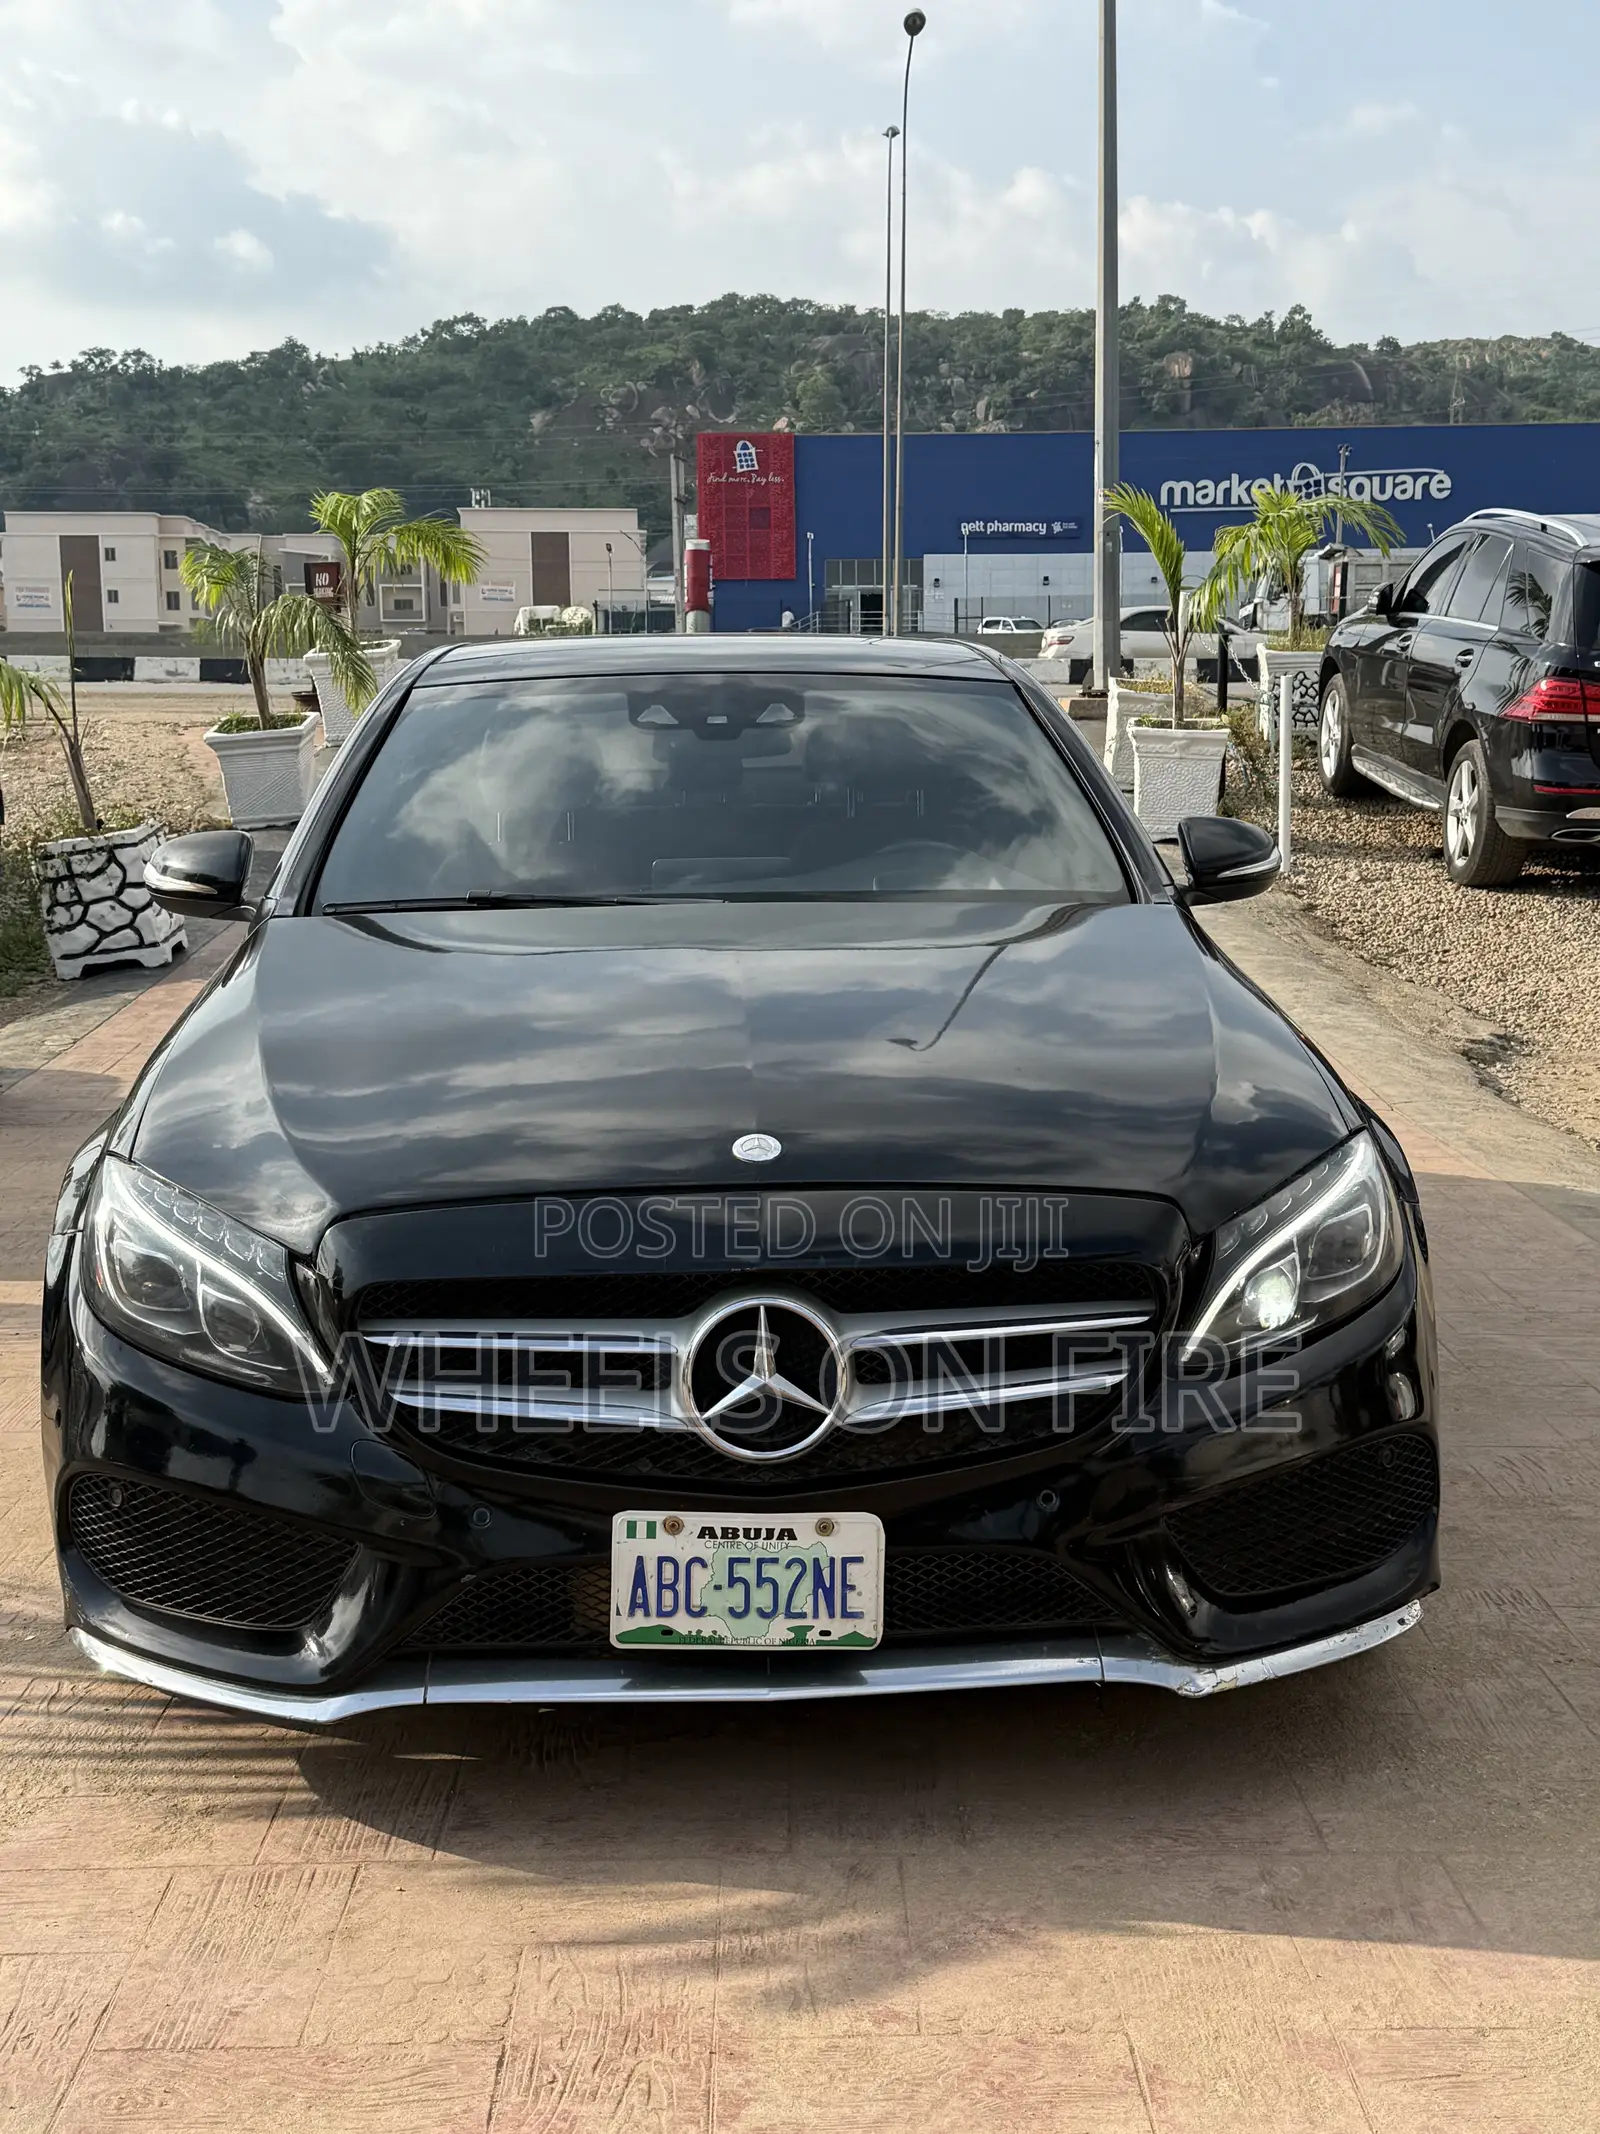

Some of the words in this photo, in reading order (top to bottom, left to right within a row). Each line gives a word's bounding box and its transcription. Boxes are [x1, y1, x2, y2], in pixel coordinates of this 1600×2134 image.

[707, 472, 728, 484] Find
[1160, 473, 1283, 505] market
[1328, 474, 1452, 504] square
[987, 519, 1047, 535] pharmacy
[697, 1526, 798, 1541] ABUJA
[704, 1540, 742, 1550] CENTRE
[744, 1541, 759, 1550] OF
[761, 1541, 790, 1550] UNITY
[627, 1555, 866, 1620] ABC-552NE
[678, 1636, 720, 1646] FEDERAL
[764, 1636, 777, 1646] OF
